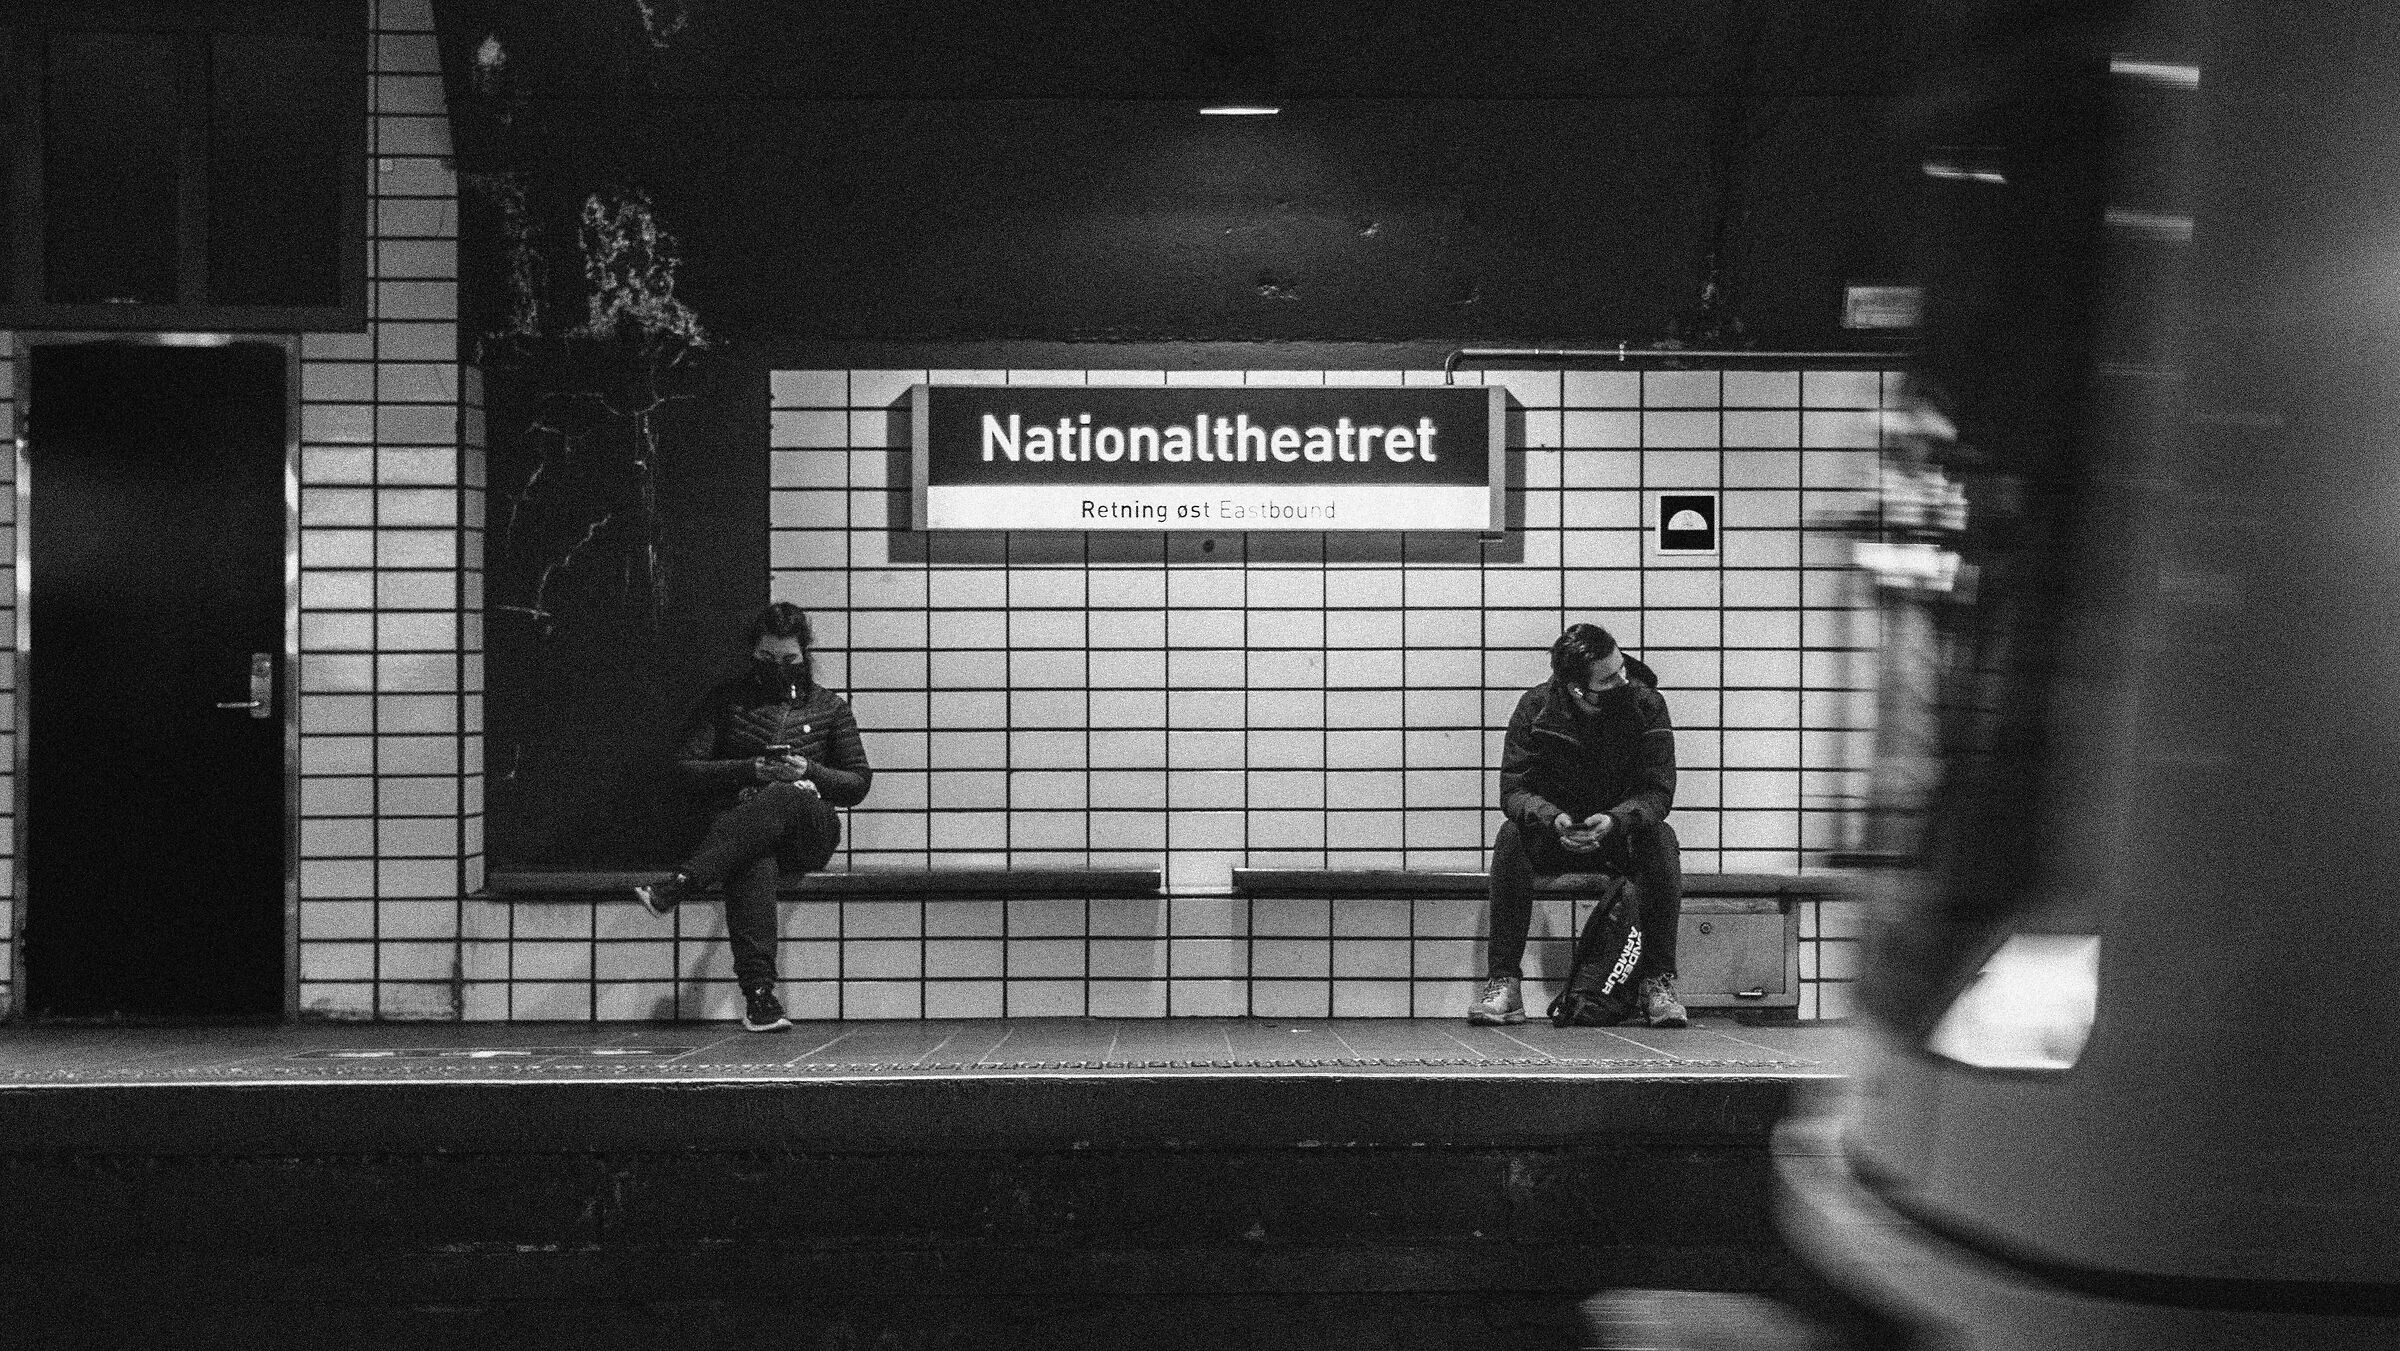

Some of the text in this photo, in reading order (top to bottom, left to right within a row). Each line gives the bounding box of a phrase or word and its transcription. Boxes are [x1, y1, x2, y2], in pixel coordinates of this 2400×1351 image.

[982, 413, 1438, 463] Nationaltheatret
[1081, 500, 1336, 523] Retning øst Eastbound
[1601, 925, 1639, 995] ARMOUR
